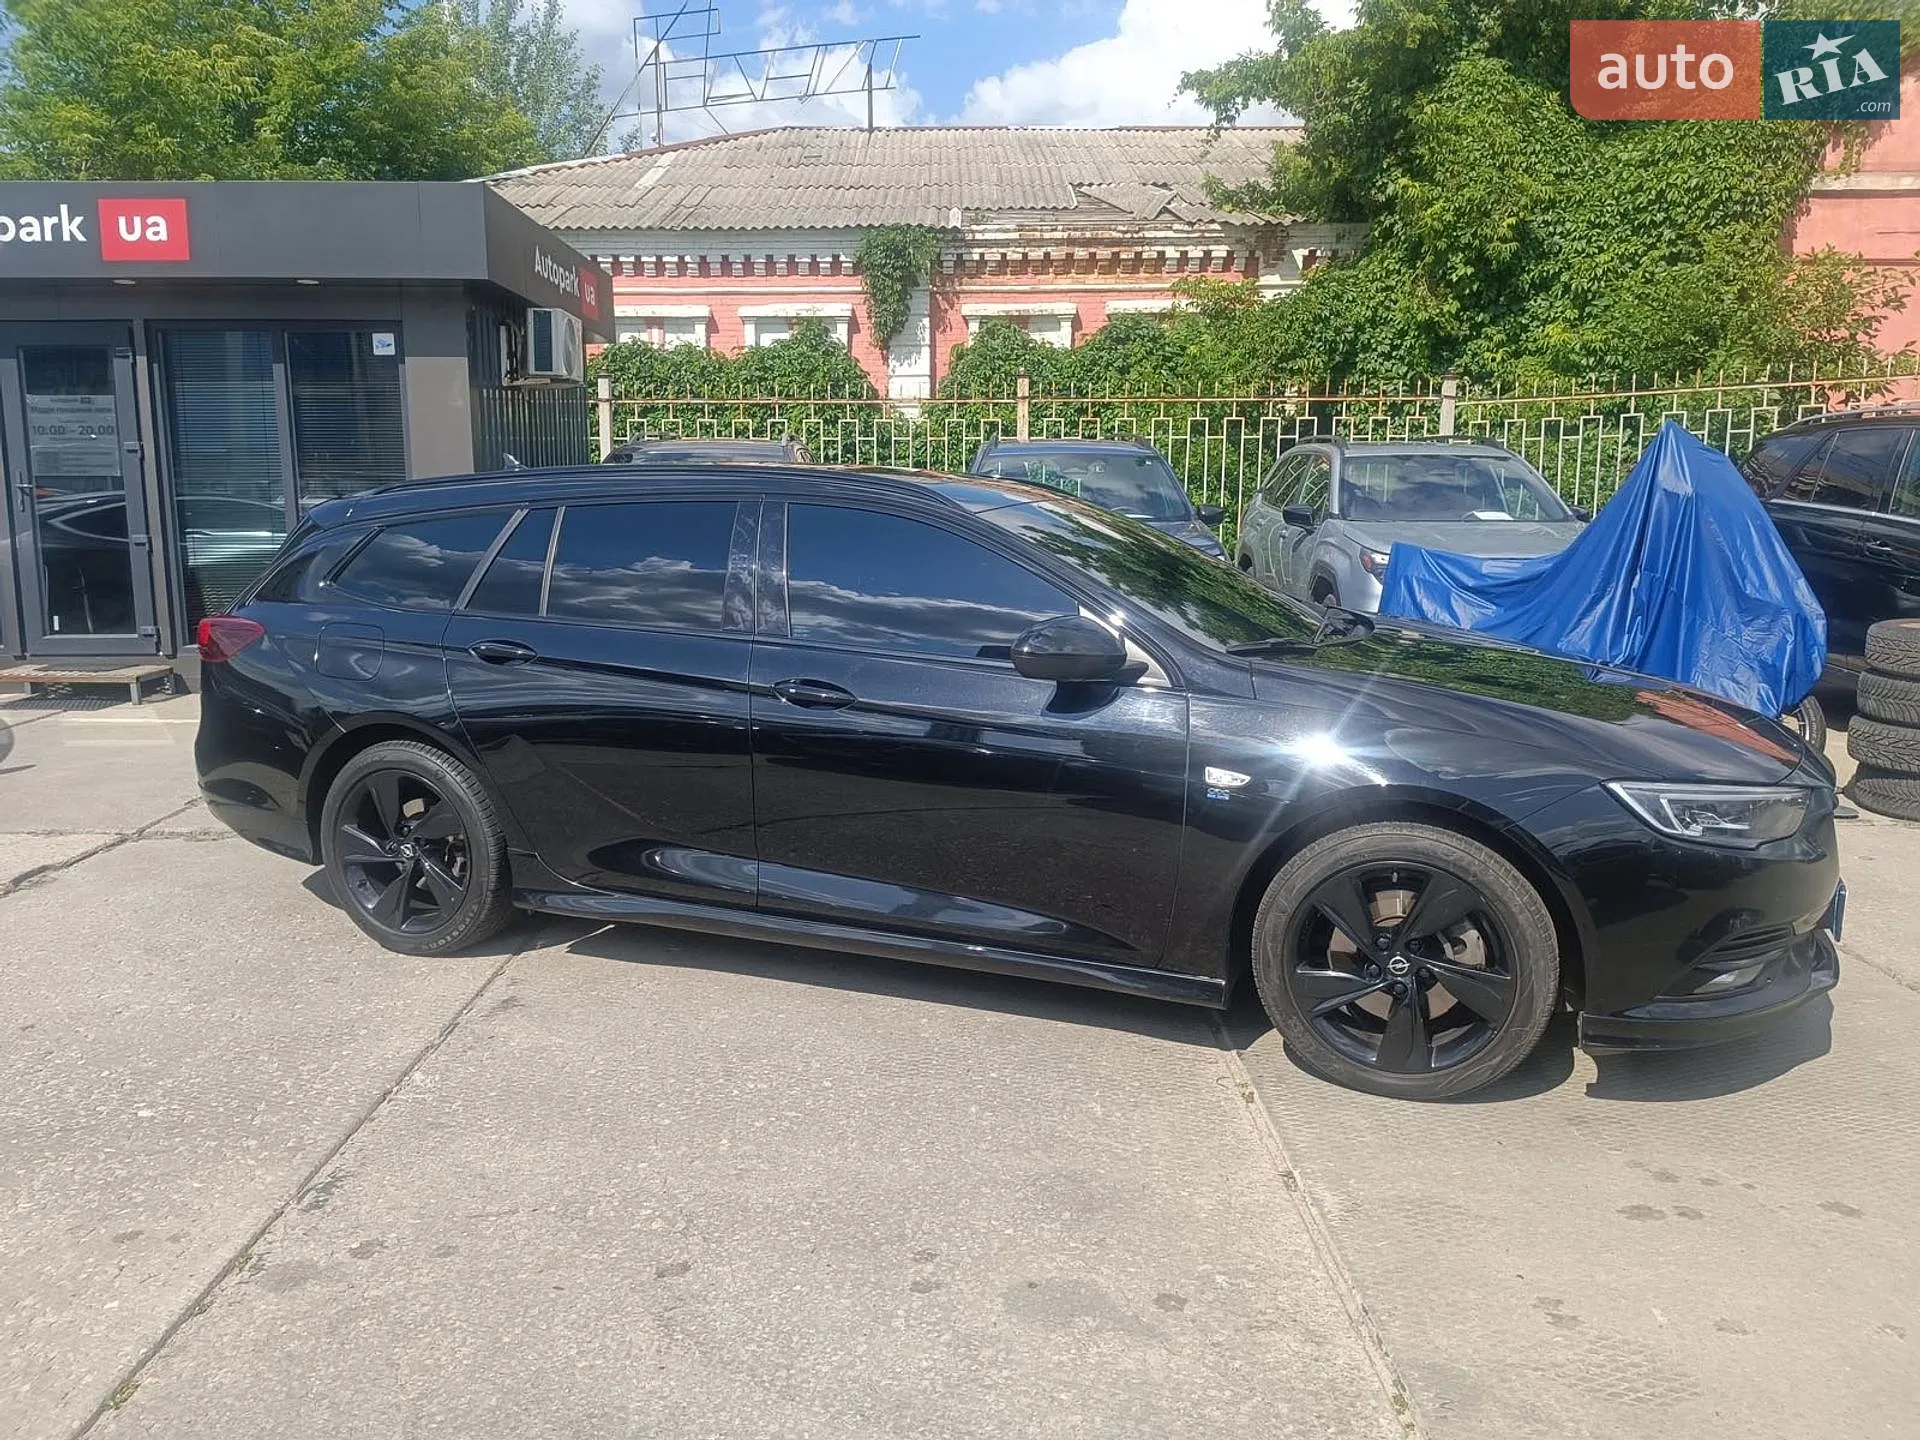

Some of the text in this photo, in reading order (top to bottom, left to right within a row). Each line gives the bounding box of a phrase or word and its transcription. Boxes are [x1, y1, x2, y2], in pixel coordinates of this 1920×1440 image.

[118, 215, 168, 242] ua
[535, 245, 596, 305] Autopark ua
[33, 425, 65, 435] 10.00
[78, 425, 114, 435] 20.00
